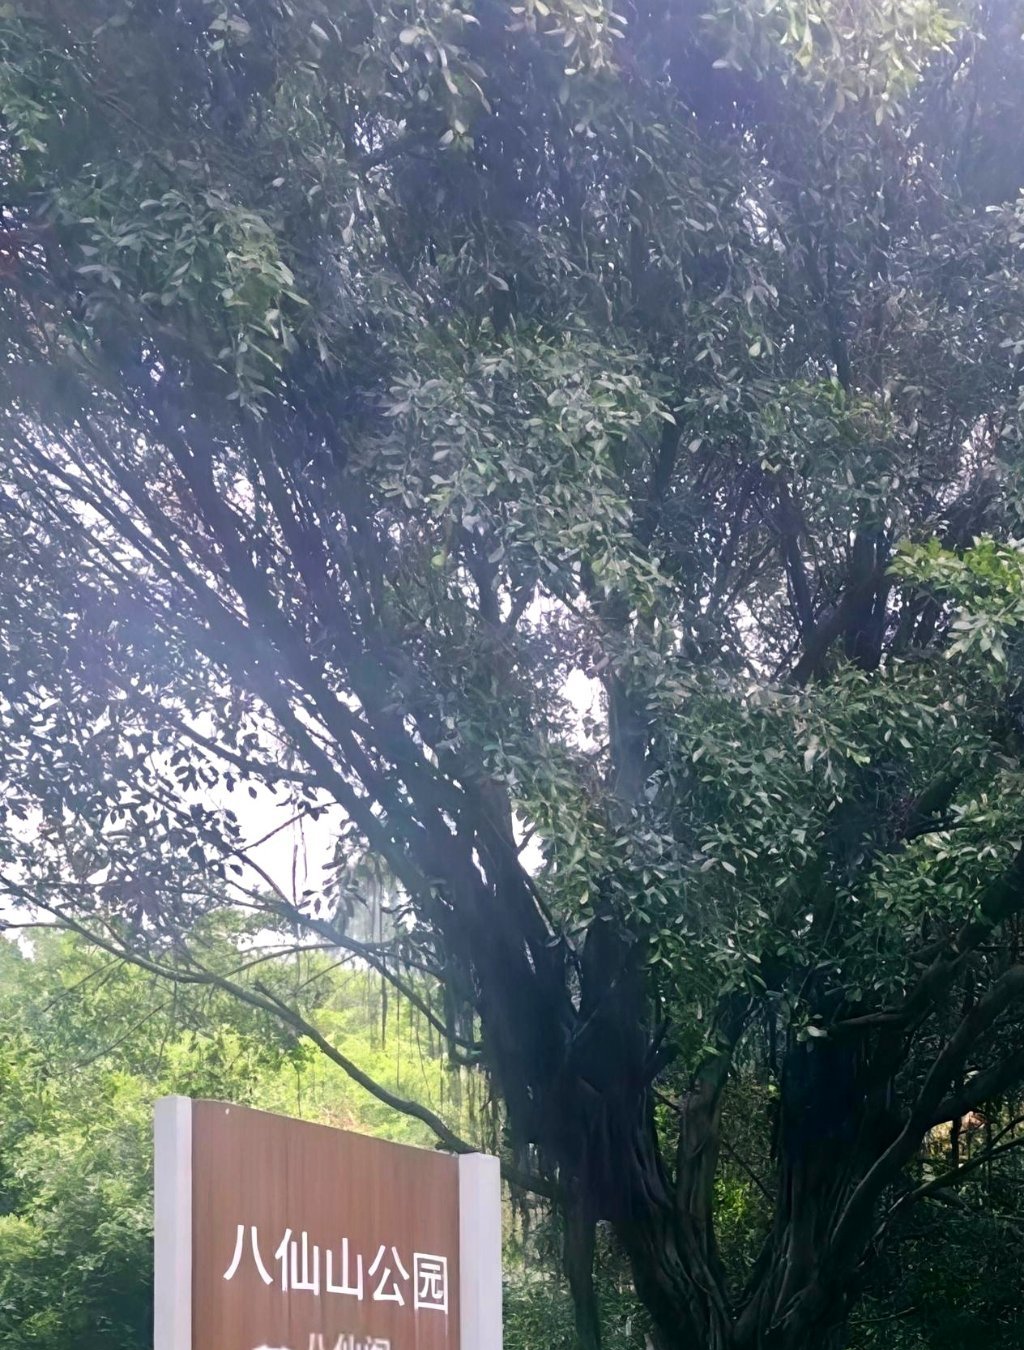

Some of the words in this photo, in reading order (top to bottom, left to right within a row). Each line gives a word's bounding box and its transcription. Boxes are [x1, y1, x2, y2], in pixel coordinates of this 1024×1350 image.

[223, 1224, 449, 1315] 八仙山公园
